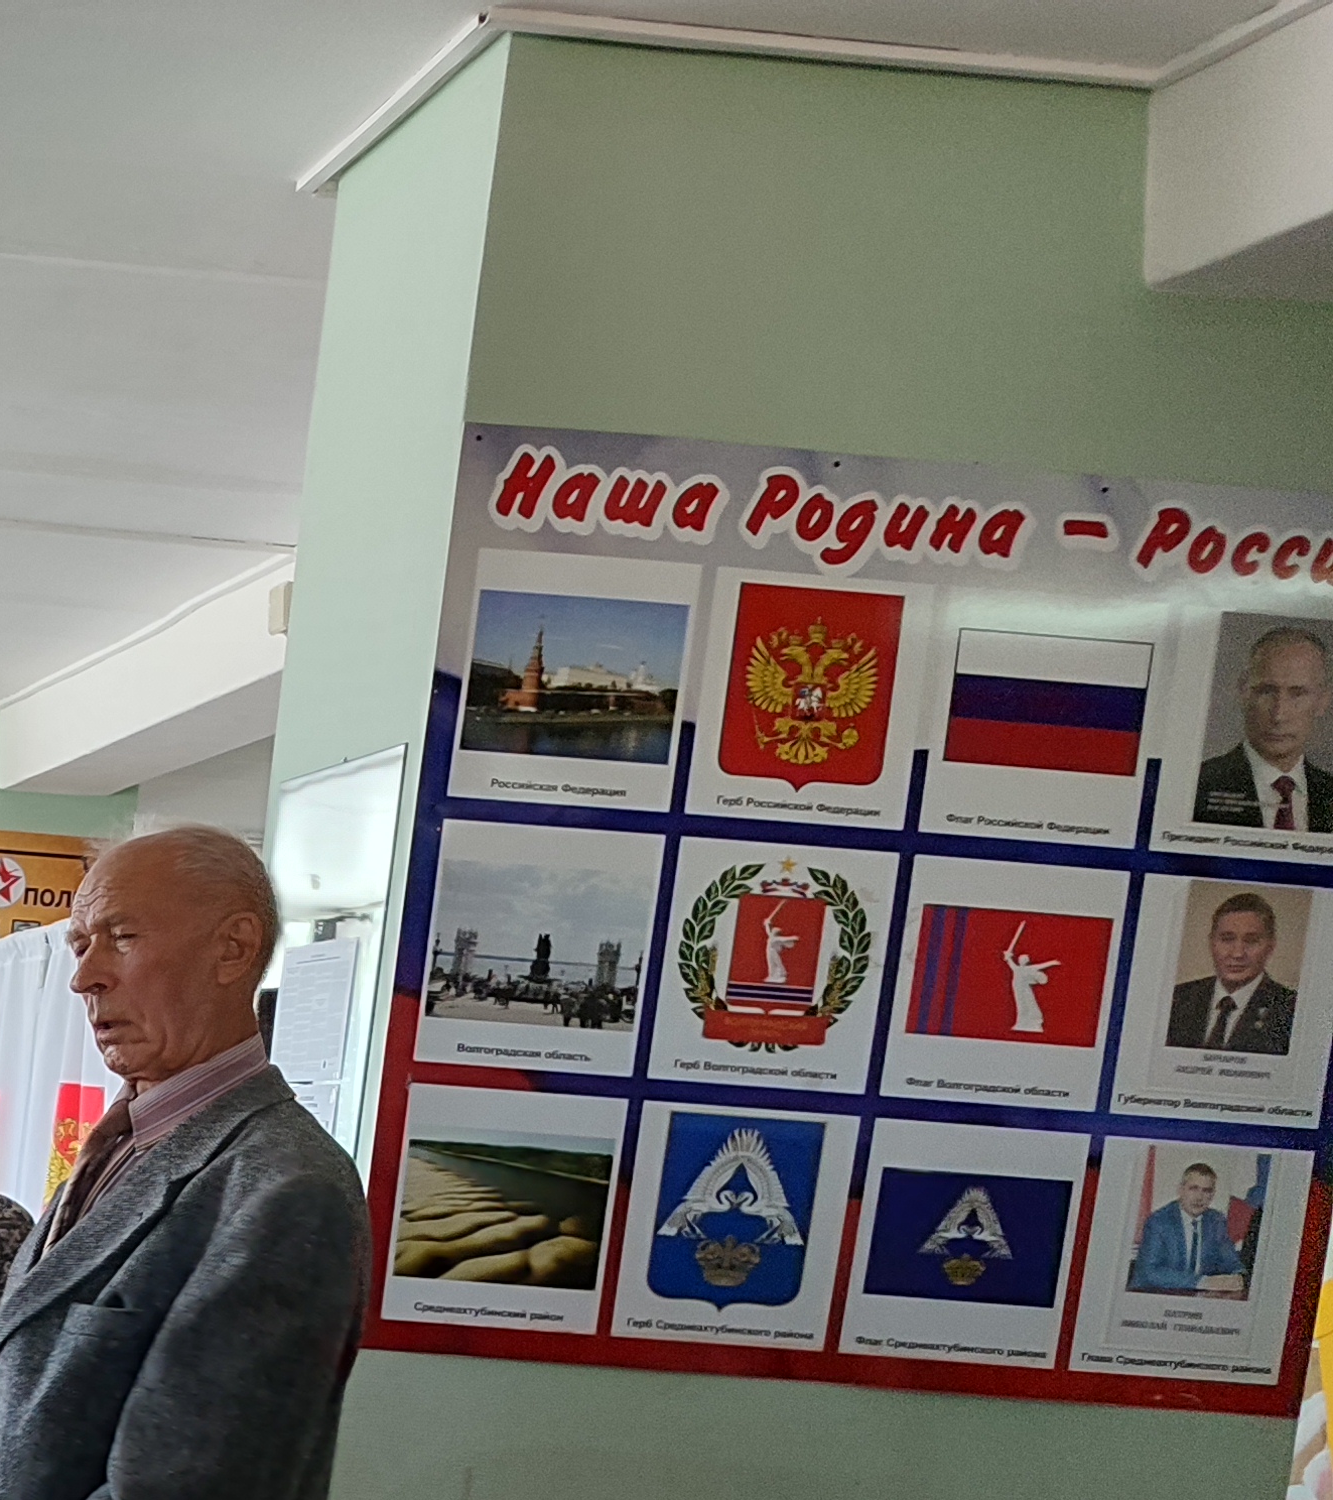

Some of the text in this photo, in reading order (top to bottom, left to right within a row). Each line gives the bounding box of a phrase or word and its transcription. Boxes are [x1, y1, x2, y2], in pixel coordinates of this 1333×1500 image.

[494, 450, 721, 533] Наша
[744, 473, 1026, 566] Родина
[1136, 506, 1333, 584] Росси
[490, 778, 626, 797] Российская Федерация
[717, 795, 881, 816] Герб Российской Федерации
[946, 814, 1110, 835] Флаг Российской Федерации
[1292, 843, 1333, 855] Федера
[457, 1043, 592, 1061] Волгоградская область
[674, 1059, 837, 1080] Герб Волгоградской области
[906, 1077, 1069, 1097] Флаг Волгоградской области
[1118, 1094, 1313, 1117] Губернатор Волгоградской области
[414, 1302, 564, 1322] Среднеахтубинский район
[627, 1318, 814, 1341] Герб Среднеахтубинского района
[855, 1336, 1047, 1359] Флаг Среднеахтубинского района
[1114, 1355, 1229, 1372] Среднеахтубинского
[1231, 1364, 1272, 1375] района
